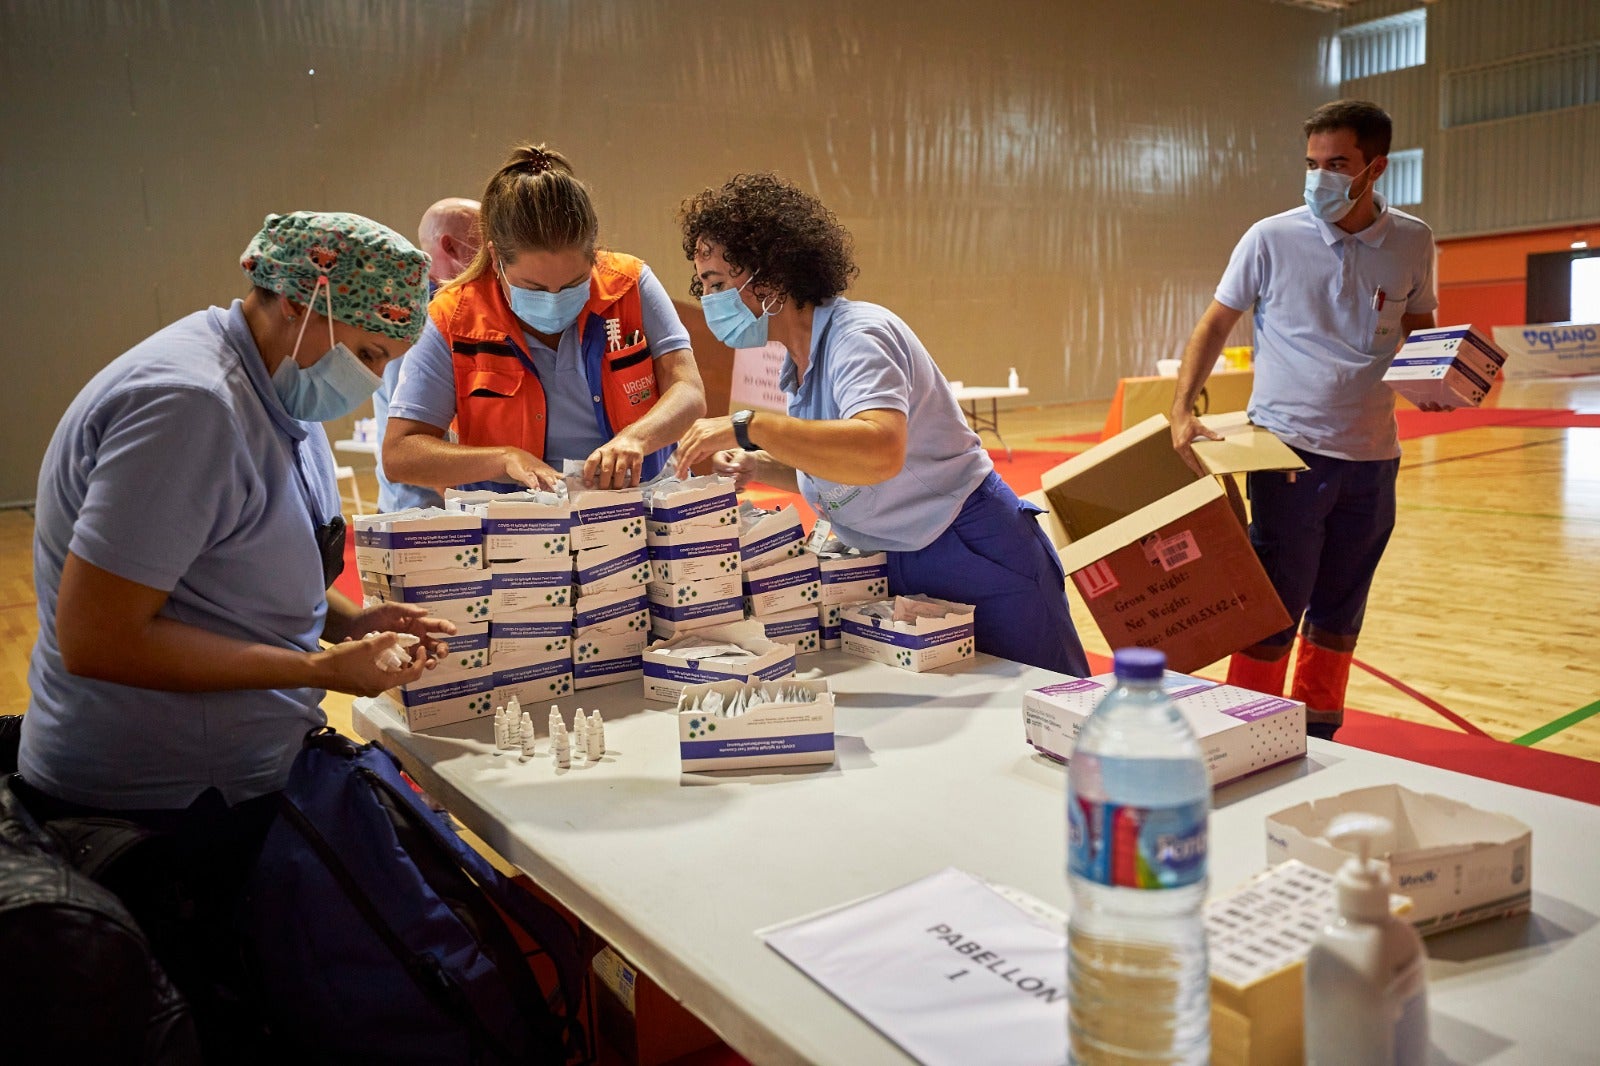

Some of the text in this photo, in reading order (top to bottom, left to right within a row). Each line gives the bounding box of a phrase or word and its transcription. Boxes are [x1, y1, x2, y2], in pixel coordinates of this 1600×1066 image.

[1114, 572, 1190, 613] Gross Weight:
[1124, 595, 1191, 633] Net Weight:
[944, 968, 970, 983] 1
